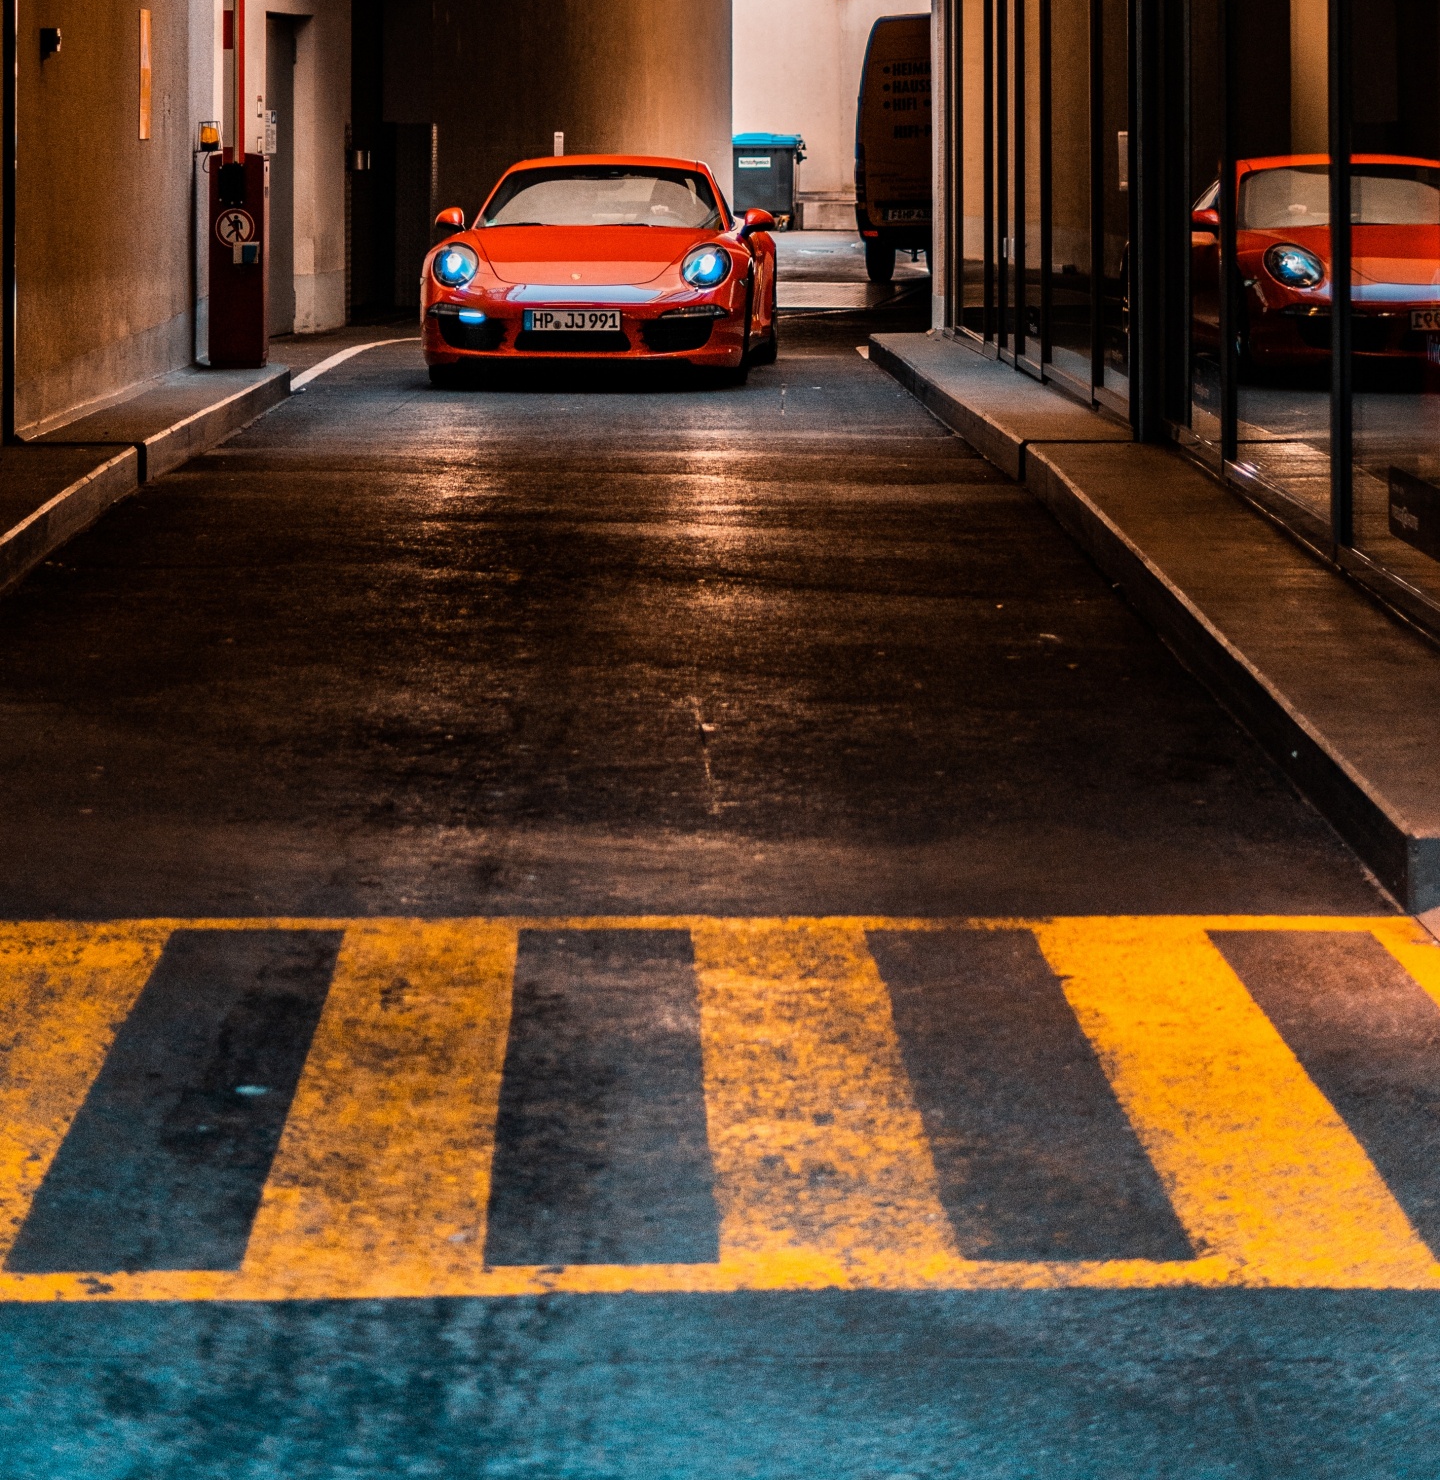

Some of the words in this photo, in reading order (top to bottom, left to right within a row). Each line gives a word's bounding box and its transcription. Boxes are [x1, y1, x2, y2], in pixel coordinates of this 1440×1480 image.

[892, 97, 918, 111] HIFI
[533, 313, 554, 328] HP
[564, 313, 585, 328] JJ
[588, 313, 618, 328] 991
